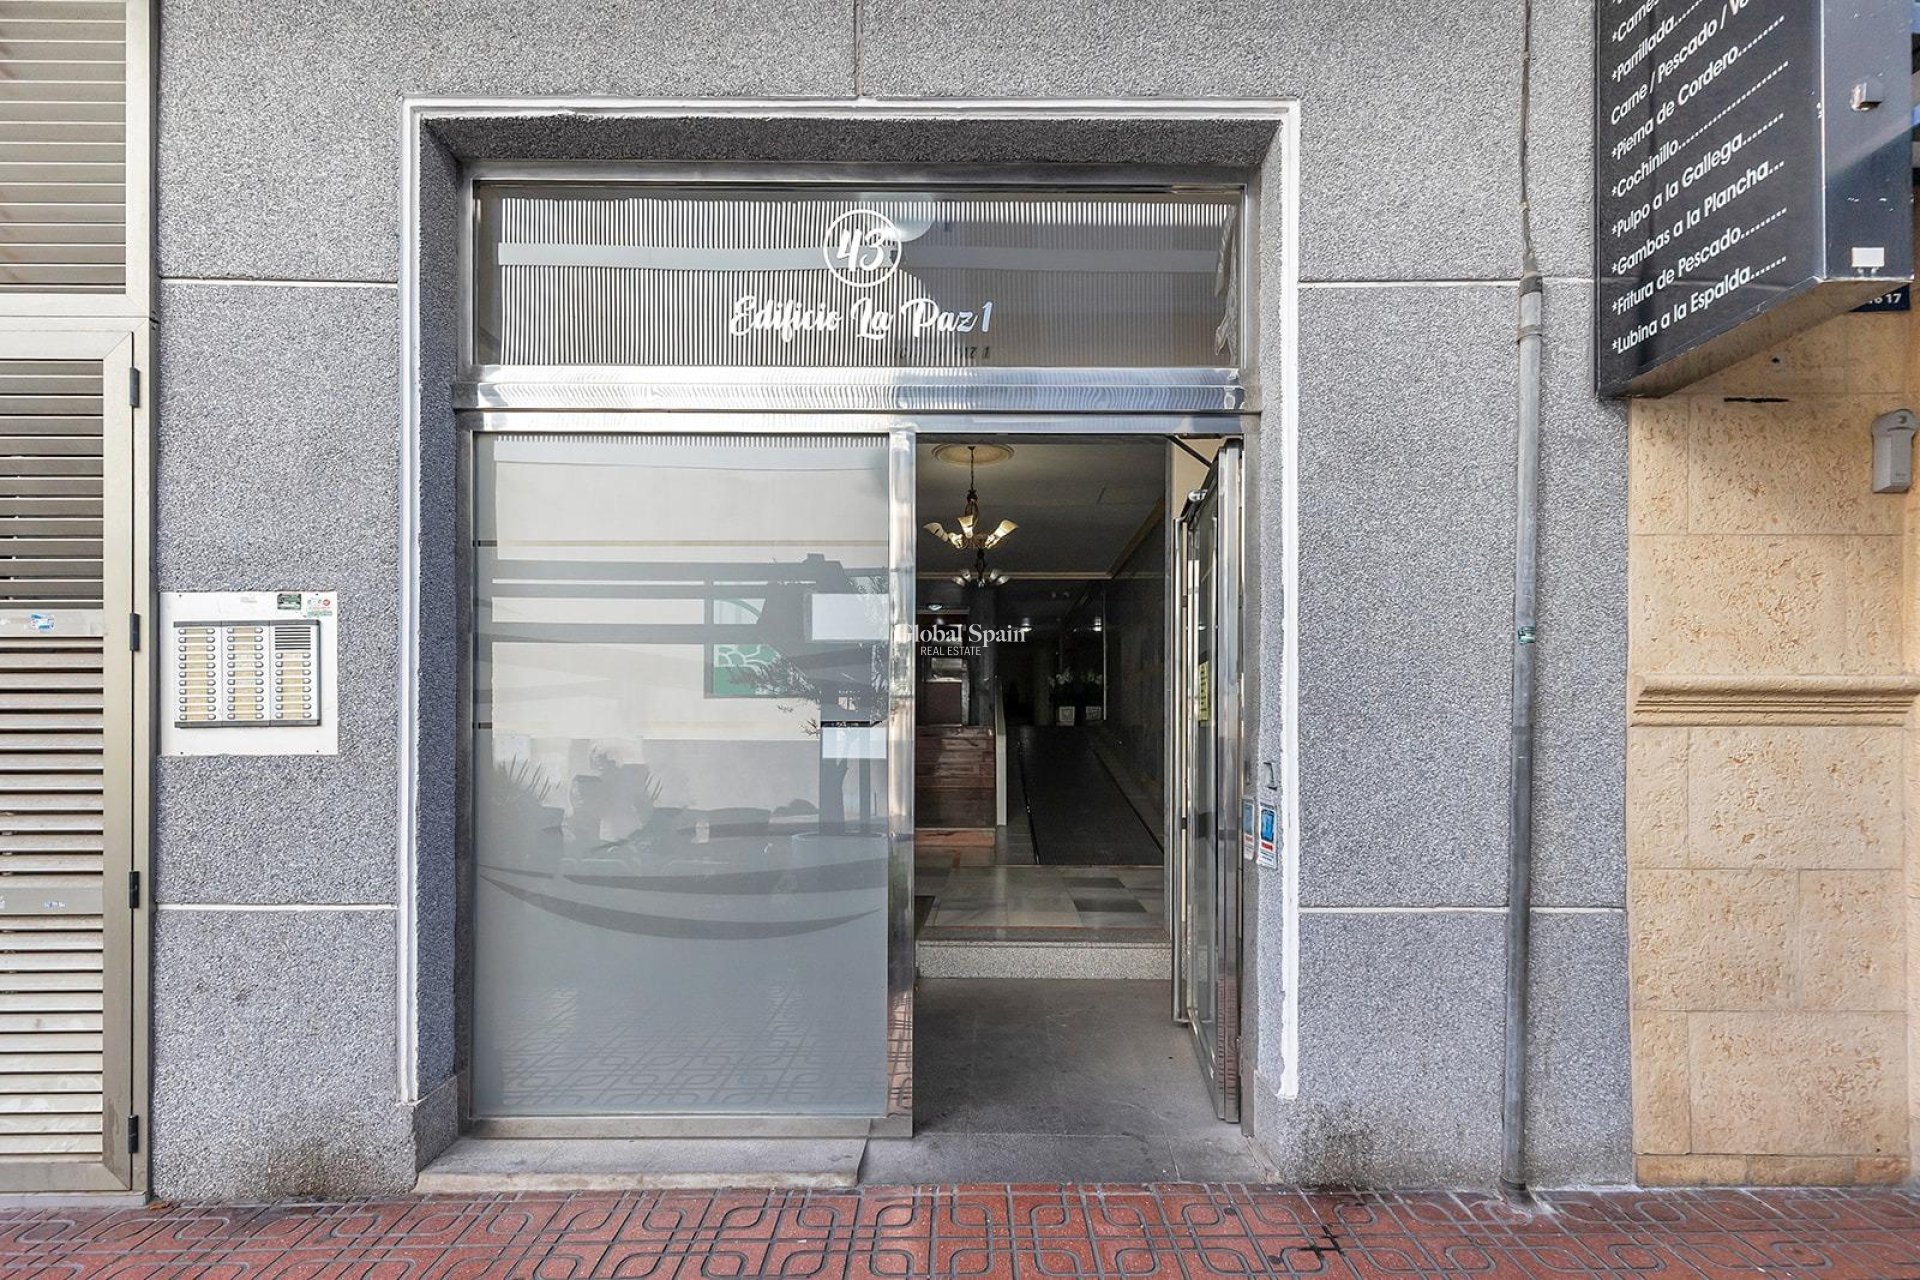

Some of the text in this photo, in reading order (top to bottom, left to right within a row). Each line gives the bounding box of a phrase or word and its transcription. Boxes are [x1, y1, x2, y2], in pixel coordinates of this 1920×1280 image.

[1611, 83, 1648, 125] Carne
[1657, 18, 1717, 84] Pescado
[1617, 117, 1654, 160] Pierna
[1656, 100, 1675, 125] de
[1617, 203, 1650, 238] Pulpo
[1653, 192, 1663, 210] a
[1665, 180, 1679, 202] la
[837, 229, 884, 271] 43
[1617, 229, 1670, 275] Gambas
[1673, 219, 1683, 237] a
[1686, 208, 1700, 230] la
[730, 295, 993, 342] Edificio La Paz 1
[1617, 282, 1654, 315] Fritura
[1656, 269, 1675, 290] de
[1617, 320, 1657, 354] Lubina
[1660, 312, 1670, 330] a
[1673, 302, 1687, 323] la
